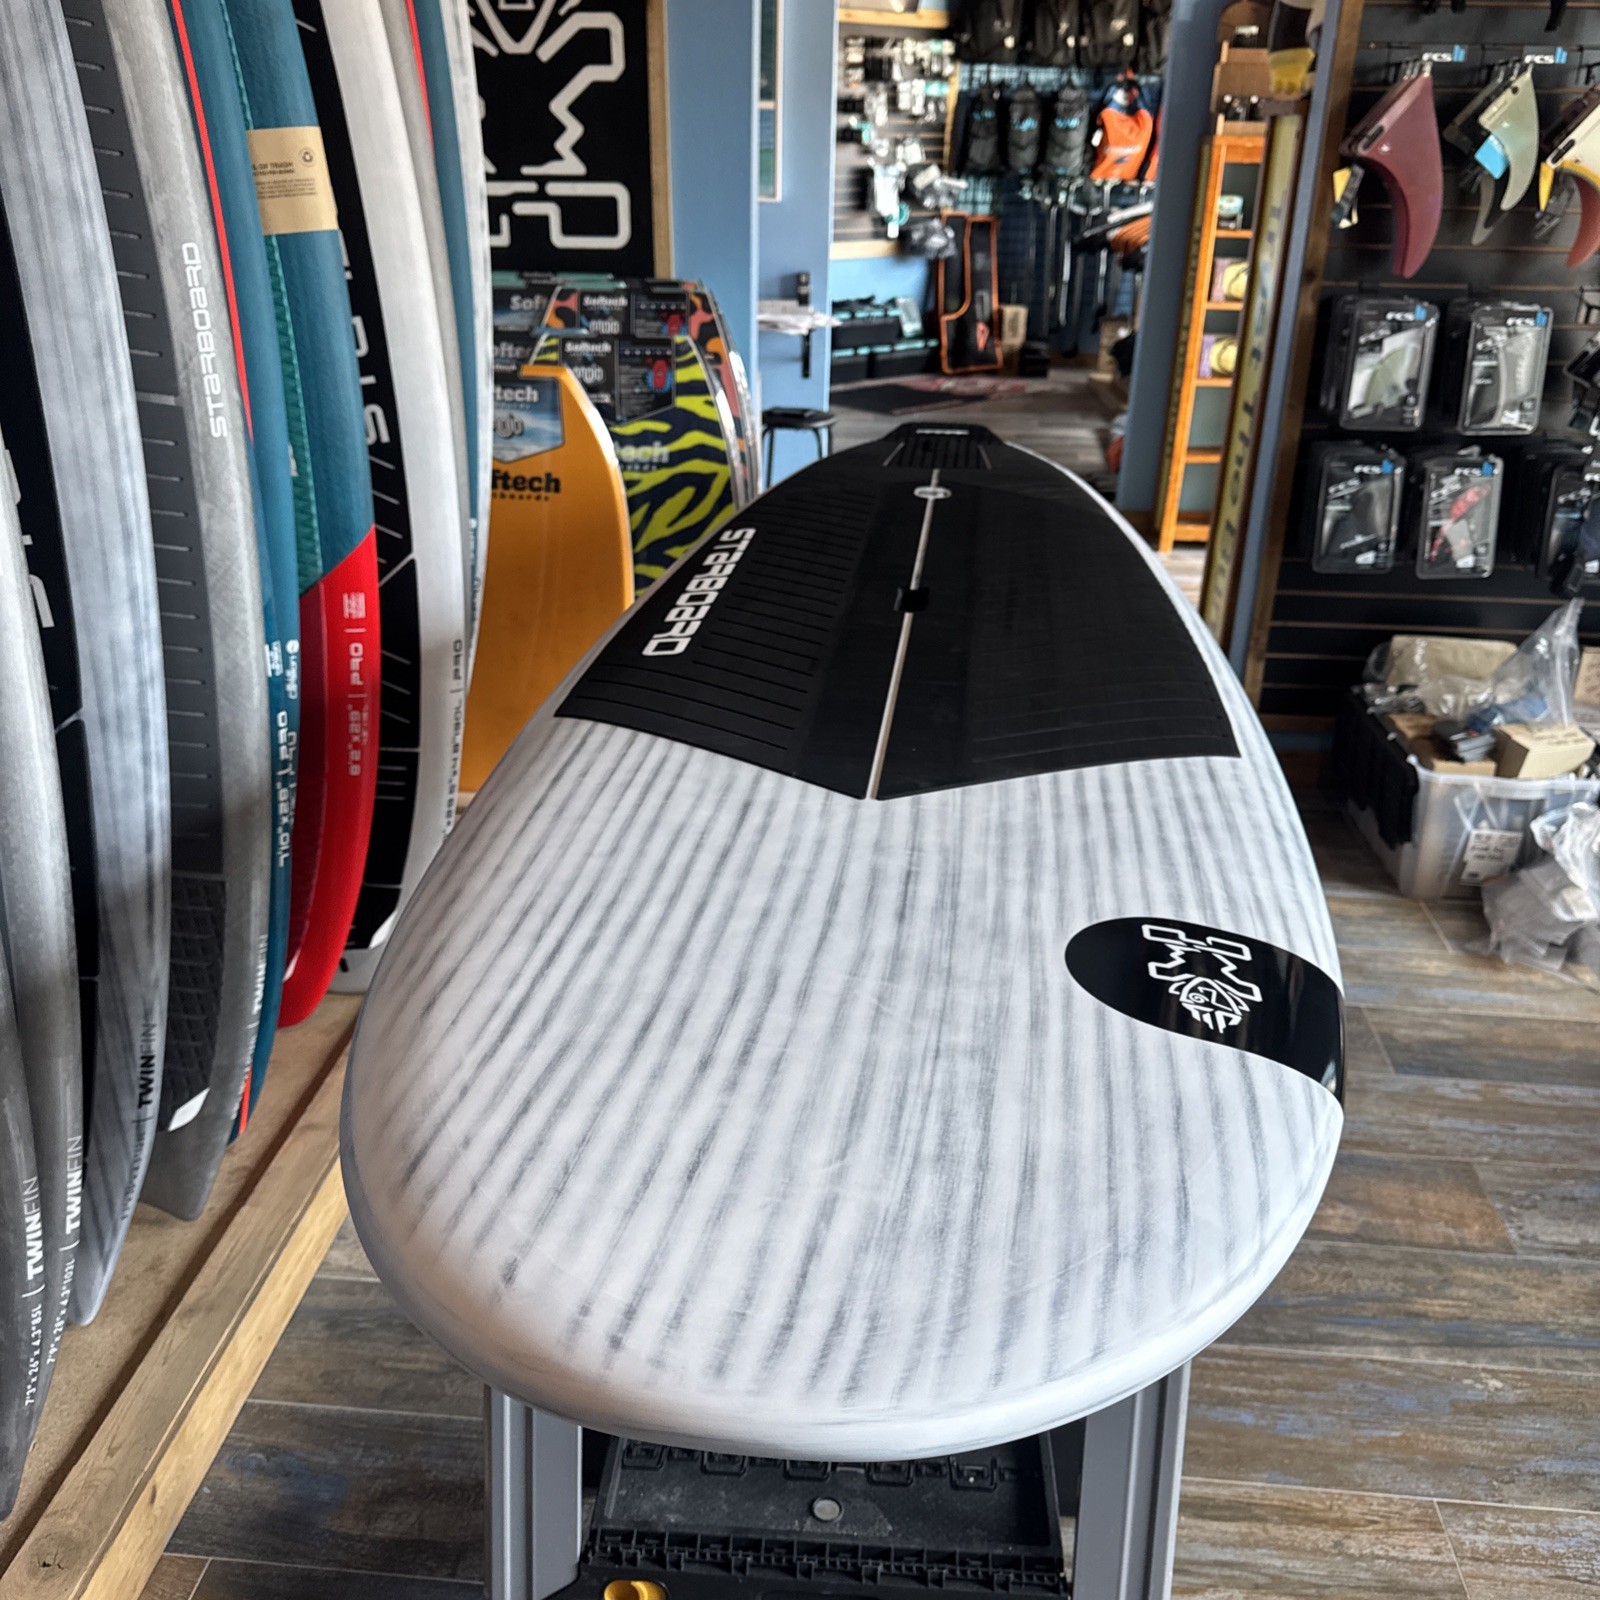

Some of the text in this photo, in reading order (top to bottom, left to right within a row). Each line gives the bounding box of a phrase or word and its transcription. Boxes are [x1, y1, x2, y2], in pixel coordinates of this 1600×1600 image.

[1422, 52, 1452, 62] FCS
[1524, 54, 1554, 64] FCS
[182, 241, 229, 438] STARBOARD
[641, 528, 756, 656] STARBOARD
[349, 642, 364, 686] PRO
[138, 1023, 156, 1109] TWINFIN
[23, 1176, 44, 1280] TWINFIN
[65, 1135, 82, 1235] TWINFIN
